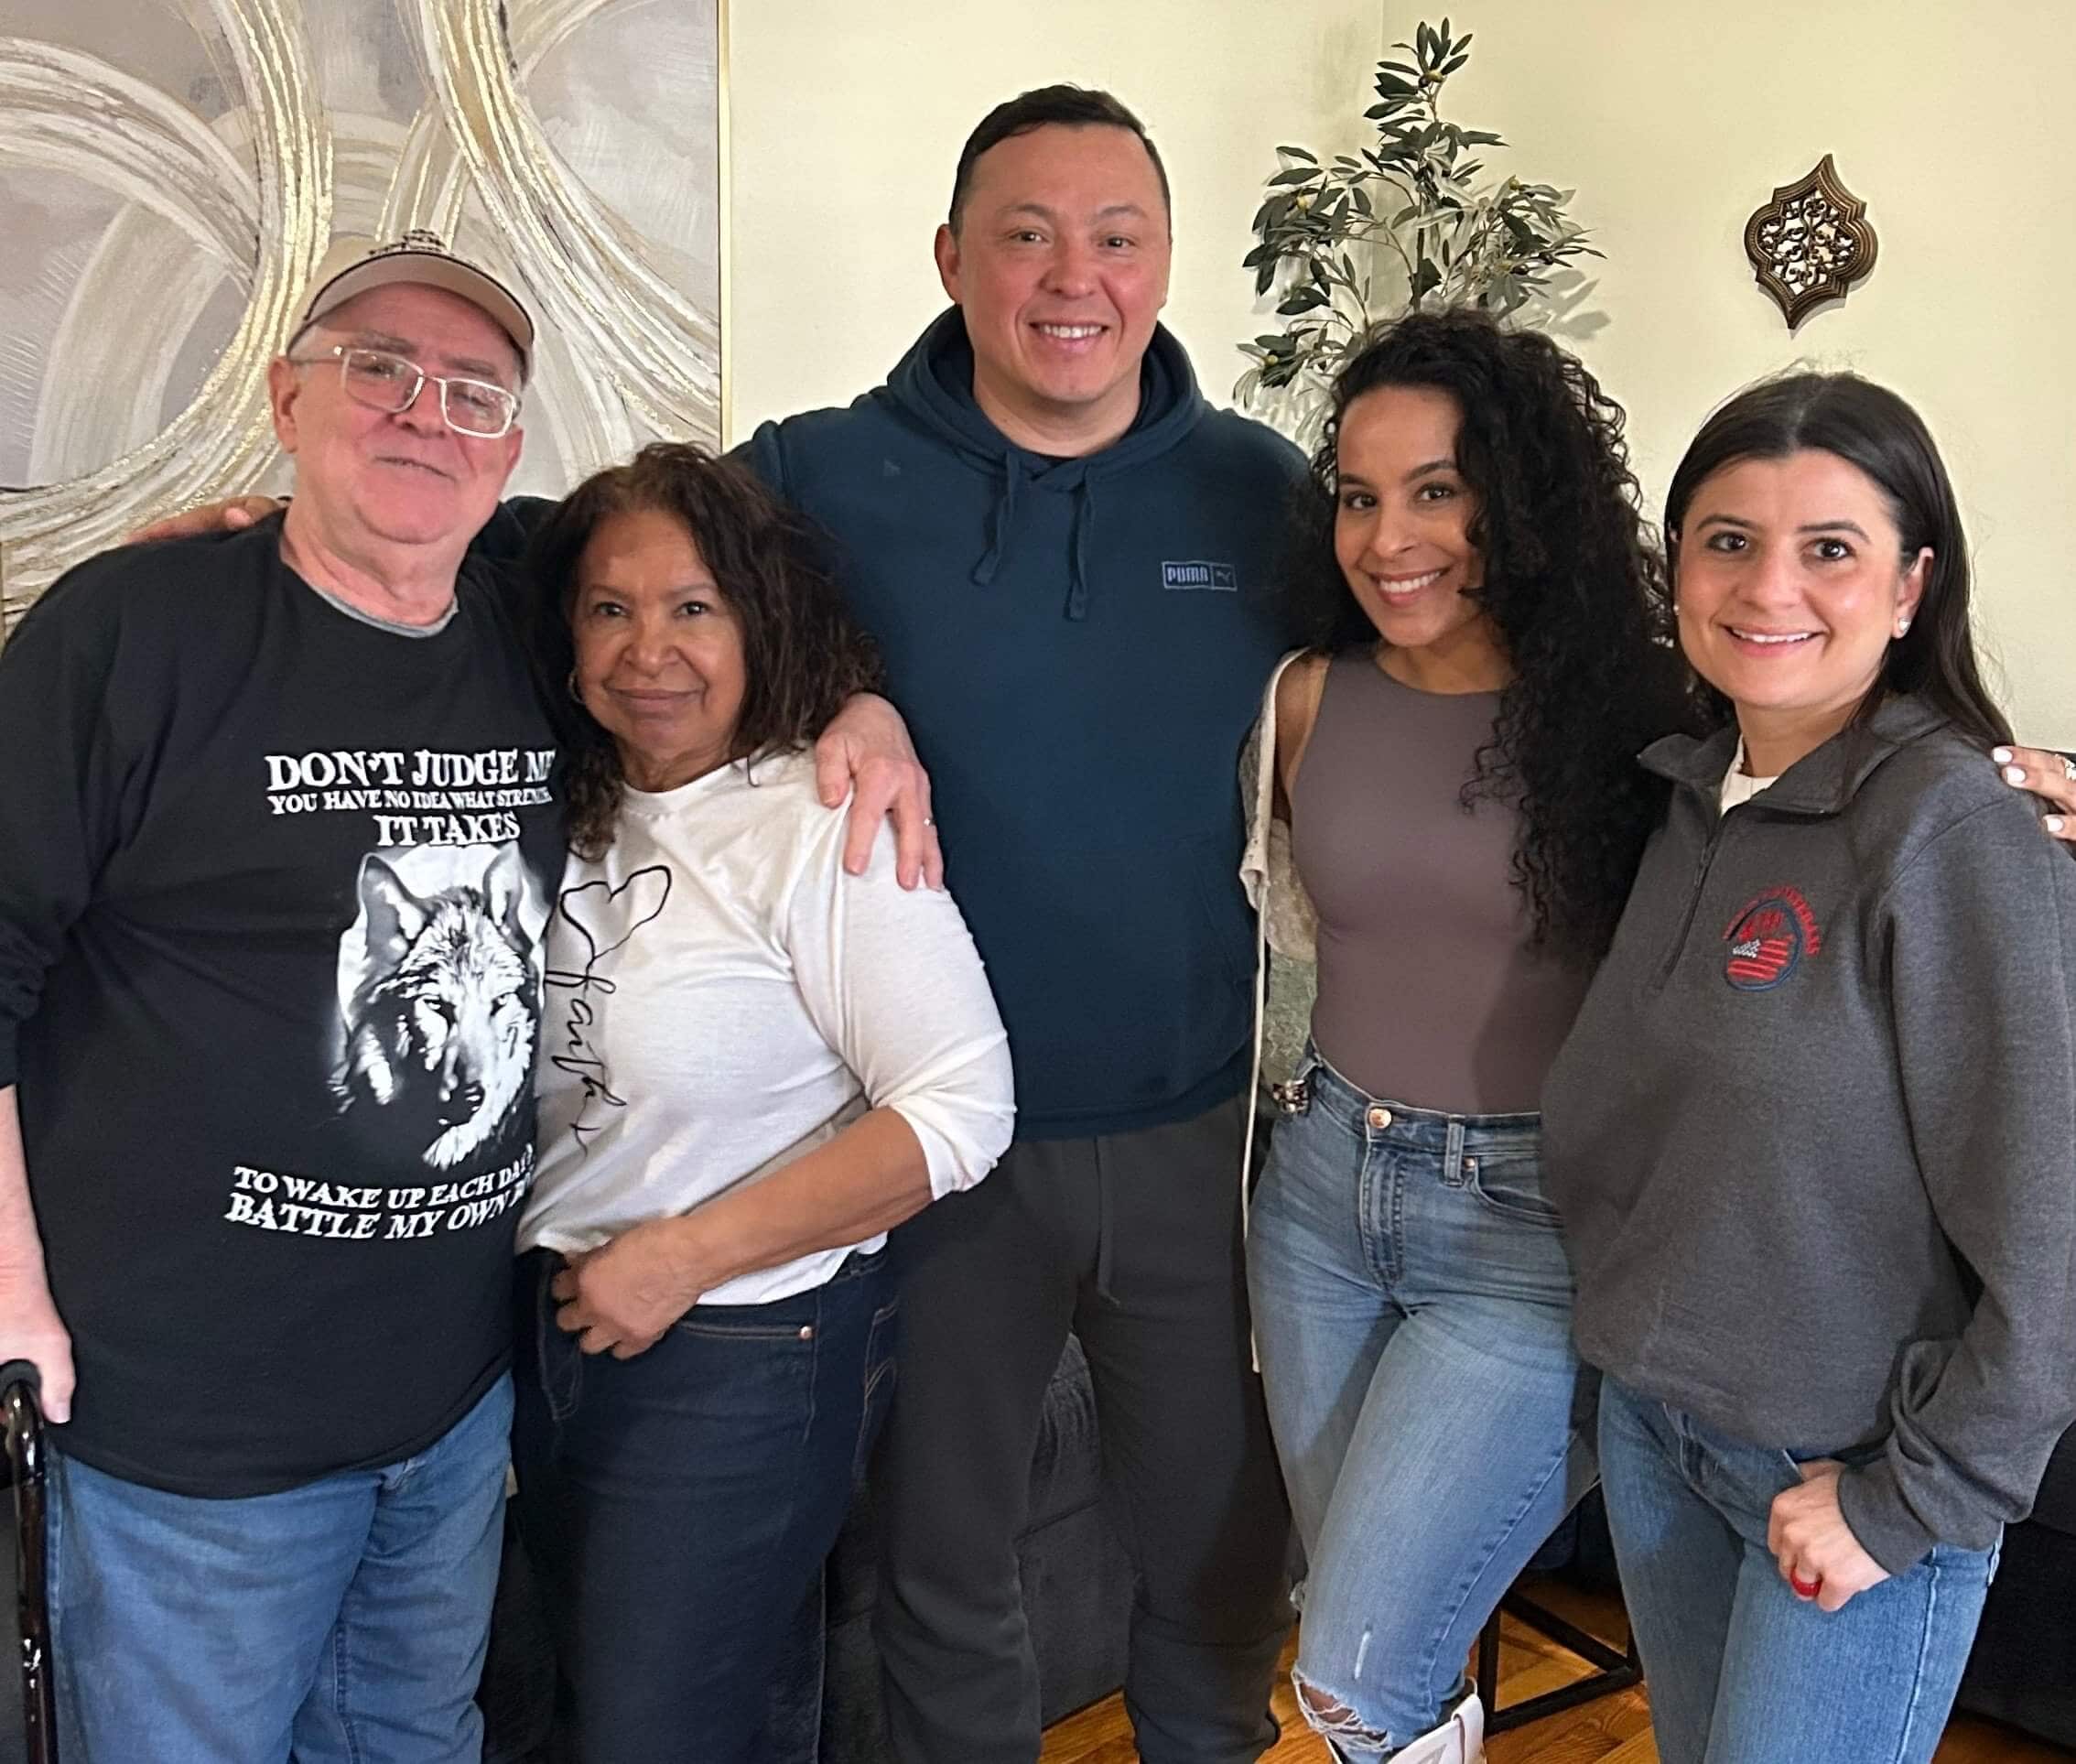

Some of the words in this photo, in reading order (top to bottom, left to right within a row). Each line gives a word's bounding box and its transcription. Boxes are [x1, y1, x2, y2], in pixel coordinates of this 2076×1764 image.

[1166, 566, 1209, 583] PUMA
[264, 750, 405, 791] DON'T
[413, 748, 519, 787] JUDGE
[266, 792, 319, 815] YOU
[322, 789, 383, 811] HAVE
[384, 789, 411, 809] NO
[412, 789, 452, 809] IDEA
[449, 789, 496, 809] WHAT
[373, 814, 418, 846] IT
[423, 809, 521, 846] TAKES
[233, 1165, 278, 1193] TO
[281, 1174, 383, 1209] WAKE
[387, 1187, 426, 1209] UP
[427, 1173, 495, 1207] EACH
[224, 1192, 381, 1239] BATTLE
[384, 1209, 446, 1239] MY
[447, 1190, 512, 1230] OWN
